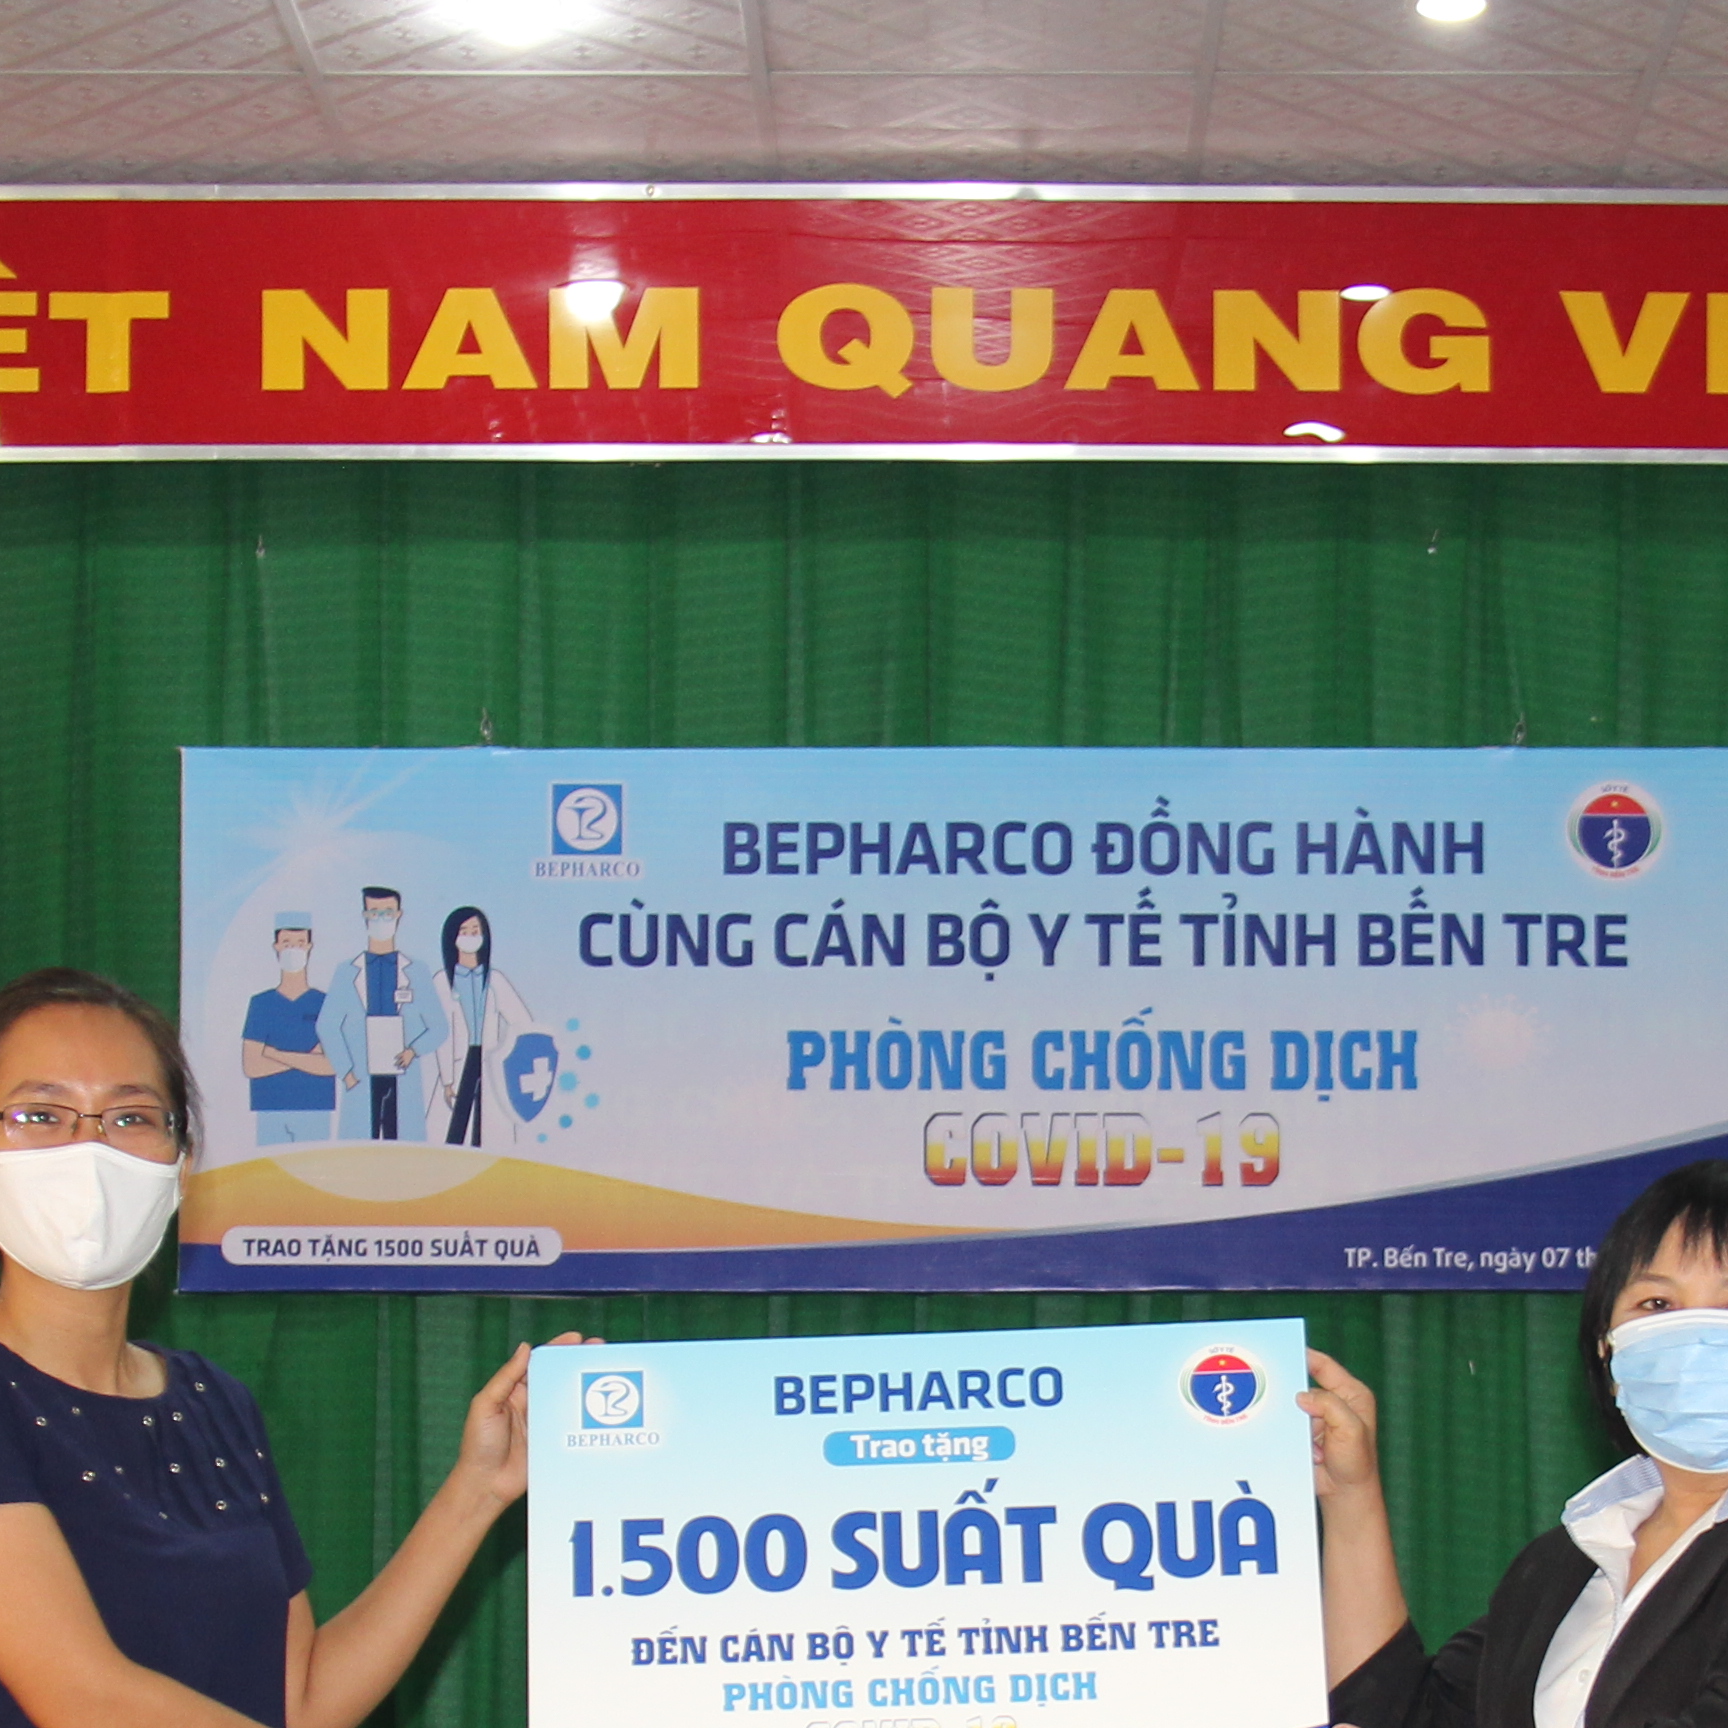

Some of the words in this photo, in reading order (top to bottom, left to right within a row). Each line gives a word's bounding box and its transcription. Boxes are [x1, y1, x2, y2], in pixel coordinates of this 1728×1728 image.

[260, 286, 701, 392] NAM
[776, 283, 1490, 398] QUANG
[723, 821, 1072, 877] BEPHARCO
[1092, 796, 1274, 877] ĐỒNG
[1296, 807, 1485, 876] HÀNH
[535, 861, 641, 878] BEPHARCO
[579, 899, 753, 968] CÙNG
[774, 898, 904, 968] CÁN
[927, 899, 1010, 981] BỘ
[1028, 913, 1069, 967] Y
[1085, 887, 1162, 967] TẾ
[1180, 893, 1336, 967] TỈNH
[1358, 886, 1484, 967] BẾN
[1502, 913, 1629, 967] TRE
[787, 1017, 1007, 1091] PHÒNG
[1031, 1006, 1246, 1091] CHỐNG
[1270, 1029, 1418, 1101] DỊCH
[923, 1111, 1281, 1187] COVID-19
[243, 1238, 301, 1257] TRAO
[308, 1234, 368, 1262] TẶNG
[374, 1238, 423, 1257] 1500
[430, 1230, 487, 1257] SUẤT
[494, 1234, 540, 1261] QUÀ
[1344, 1247, 1377, 1268] TP.
[1384, 1244, 1427, 1268] Bến
[1432, 1247, 1475, 1272] Tre,
[1480, 1246, 1535, 1273] ngày
[1541, 1247, 1571, 1268] 07
[774, 1366, 1064, 1416] BEPHARCO
[567, 1431, 660, 1448] BEPHARCO
[850, 1433, 916, 1459] Trao
[921, 1430, 989, 1463] tặng
[569, 1513, 808, 1598] 1.500
[831, 1477, 1057, 1591] SUẤT
[1081, 1480, 1279, 1591] QUÀ
[631, 1626, 707, 1666] ĐẾN
[719, 1626, 795, 1663] CÁN
[806, 1625, 855, 1666] BỘ
[867, 1630, 889, 1658] Y
[900, 1617, 948, 1658] TẾ
[957, 1618, 1049, 1656] TỈNH
[1060, 1611, 1137, 1653] BẾN
[1147, 1618, 1221, 1650] TRE
[722, 1674, 854, 1712] PHÒNG
[867, 1666, 996, 1708] CHỐNG
[1009, 1671, 1098, 1707] DỊCH
